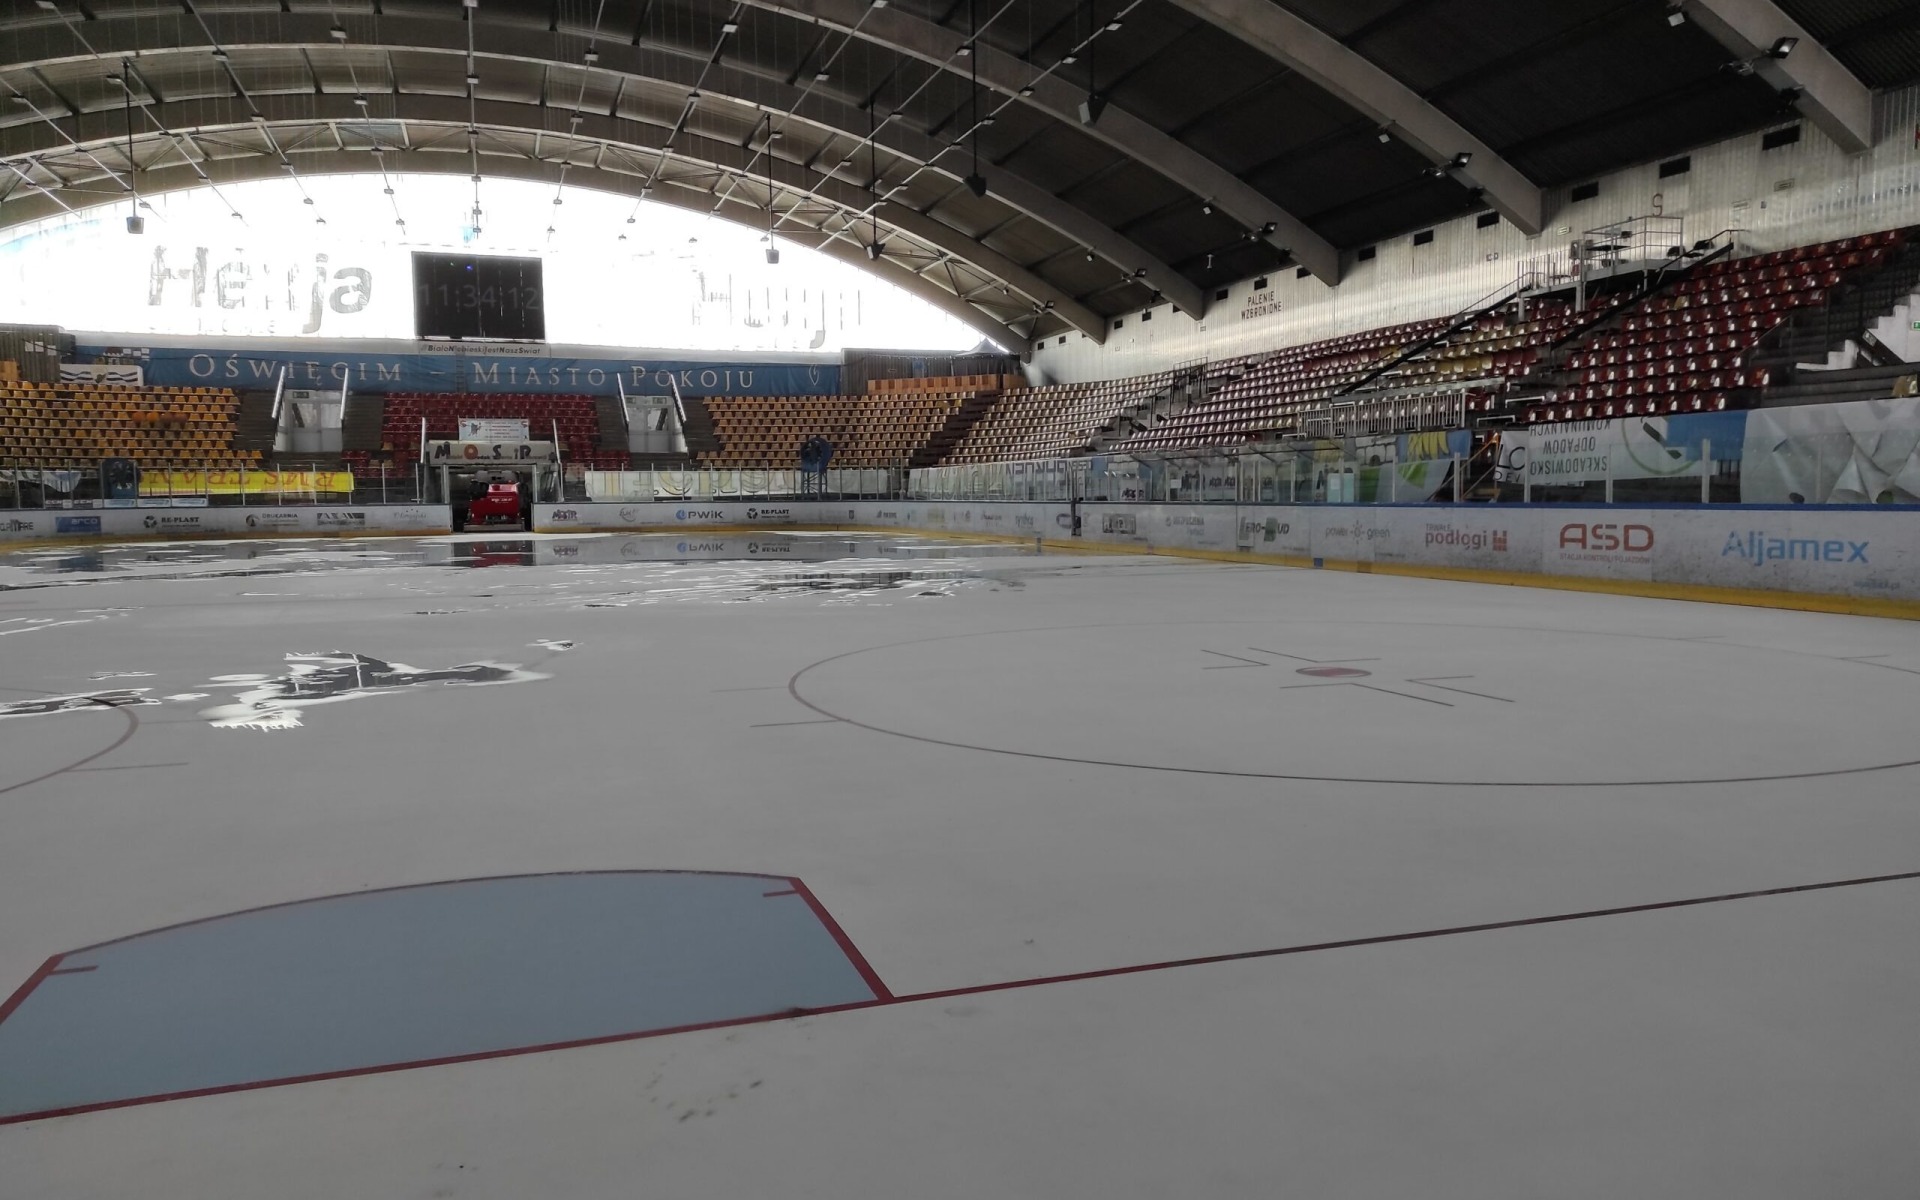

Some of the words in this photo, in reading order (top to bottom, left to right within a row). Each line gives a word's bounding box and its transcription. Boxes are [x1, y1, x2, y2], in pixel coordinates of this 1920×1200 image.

[1247, 291, 1275, 306] PALENIE
[1241, 301, 1282, 320] WZBRONIONE
[472, 362, 606, 386] MIASTO
[631, 365, 754, 391] POKOJU
[1543, 436, 1596, 458] ODPADÓW
[1530, 456, 1608, 476] SKŁADOWISKO
[1425, 530, 1487, 549] podłogi
[1559, 523, 1655, 551] ASD
[1722, 530, 1870, 567] Aljamex
